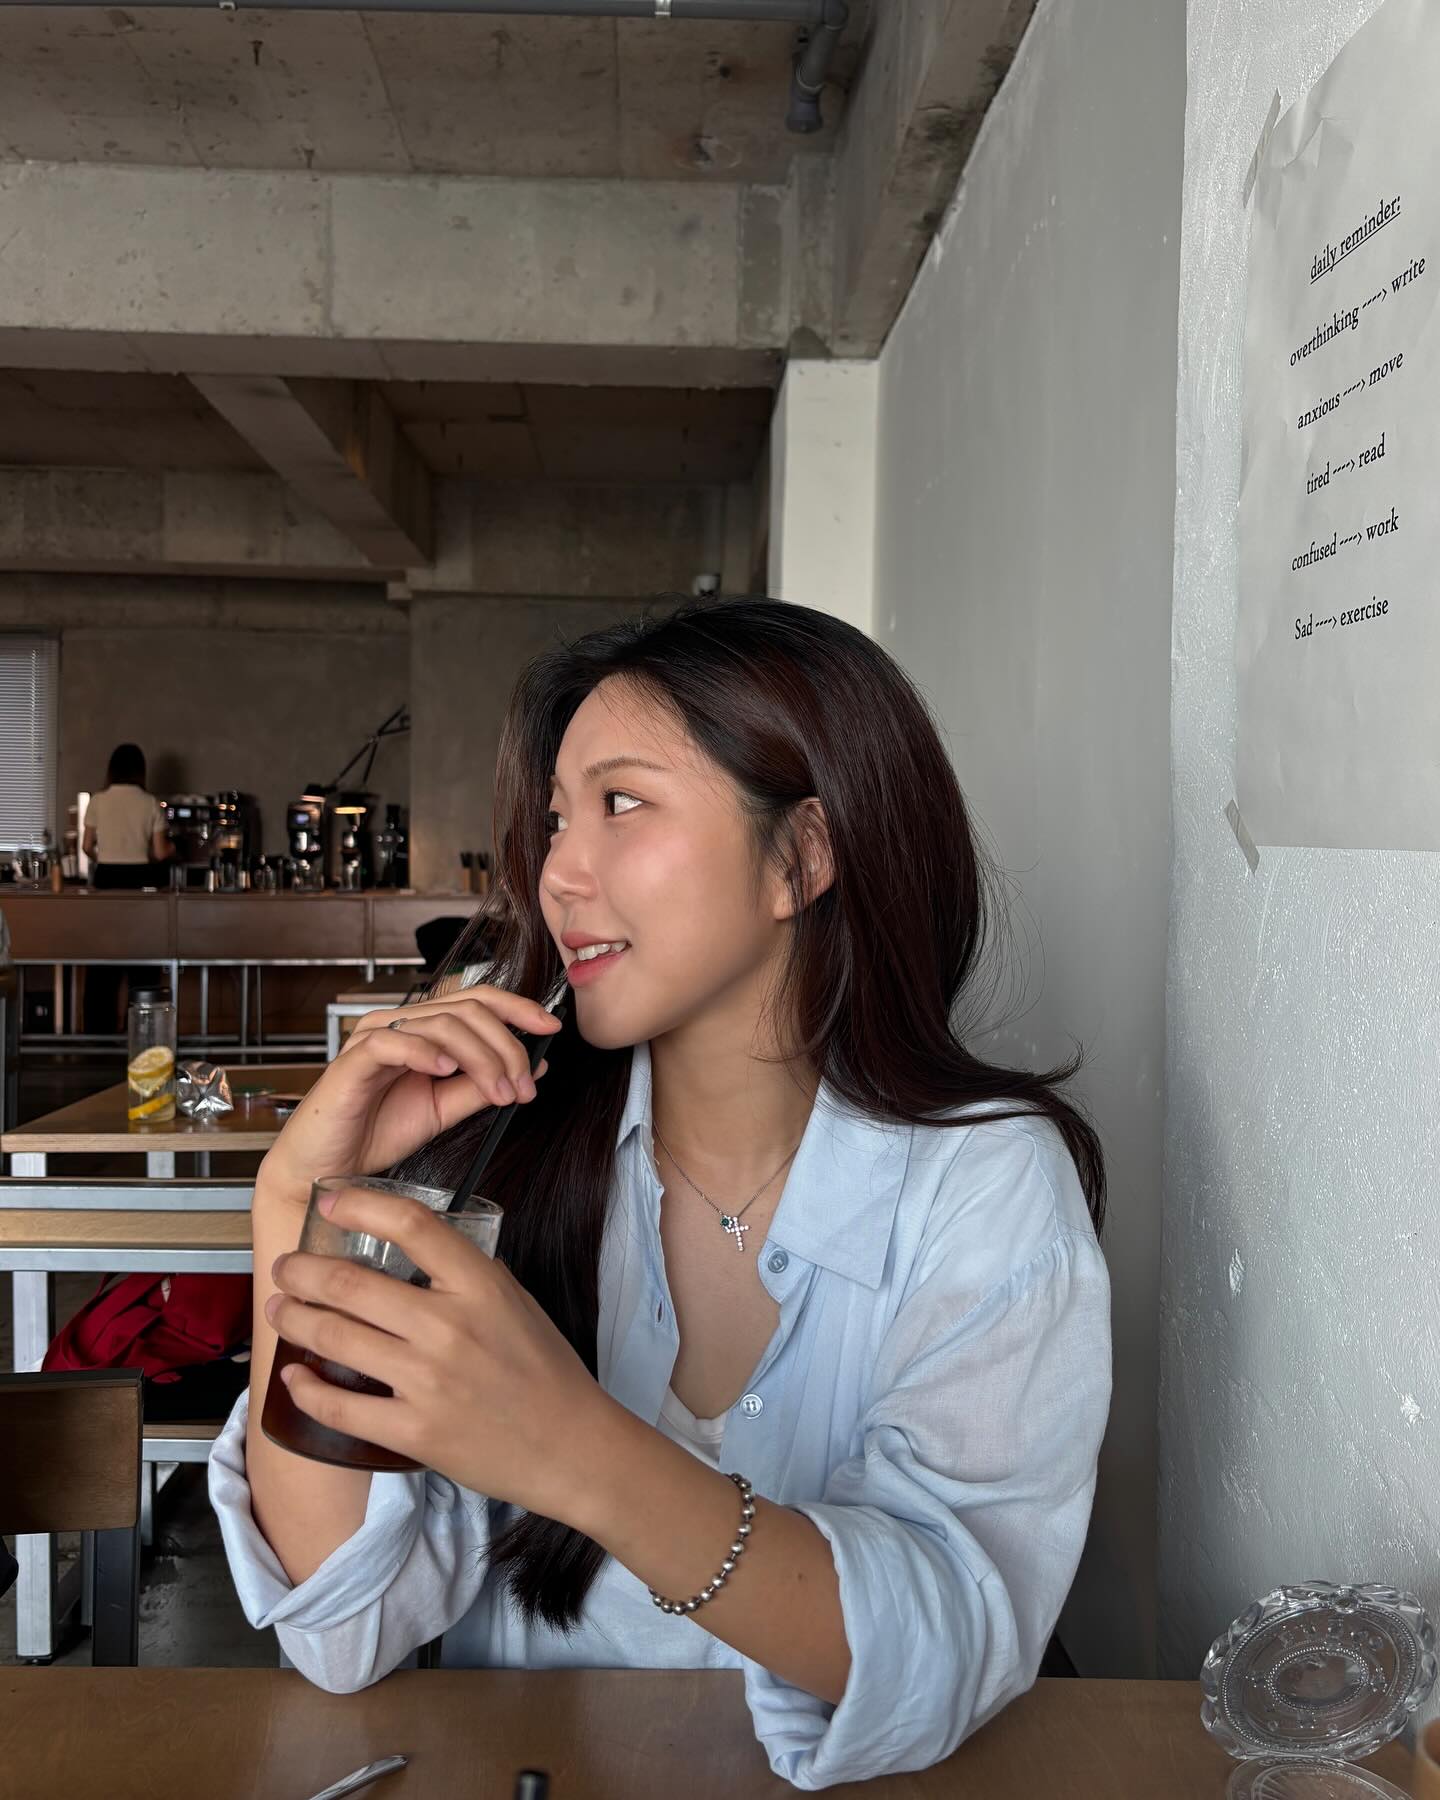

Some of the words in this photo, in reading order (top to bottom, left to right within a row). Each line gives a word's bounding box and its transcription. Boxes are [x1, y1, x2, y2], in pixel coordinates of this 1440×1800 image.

[1310, 243, 1338, 280] daily
[1340, 195, 1401, 256] reminder:
[1290, 306, 1360, 367] overthinking
[1391, 257, 1426, 294] write
[1297, 392, 1341, 430] anxious
[1368, 352, 1404, 387] move
[1306, 460, 1330, 495] tired
[1358, 431, 1386, 468] read
[1291, 531, 1337, 572] confused
[1365, 506, 1399, 541] work
[1294, 612, 1313, 640] Sad
[1340, 595, 1389, 627] exercise
